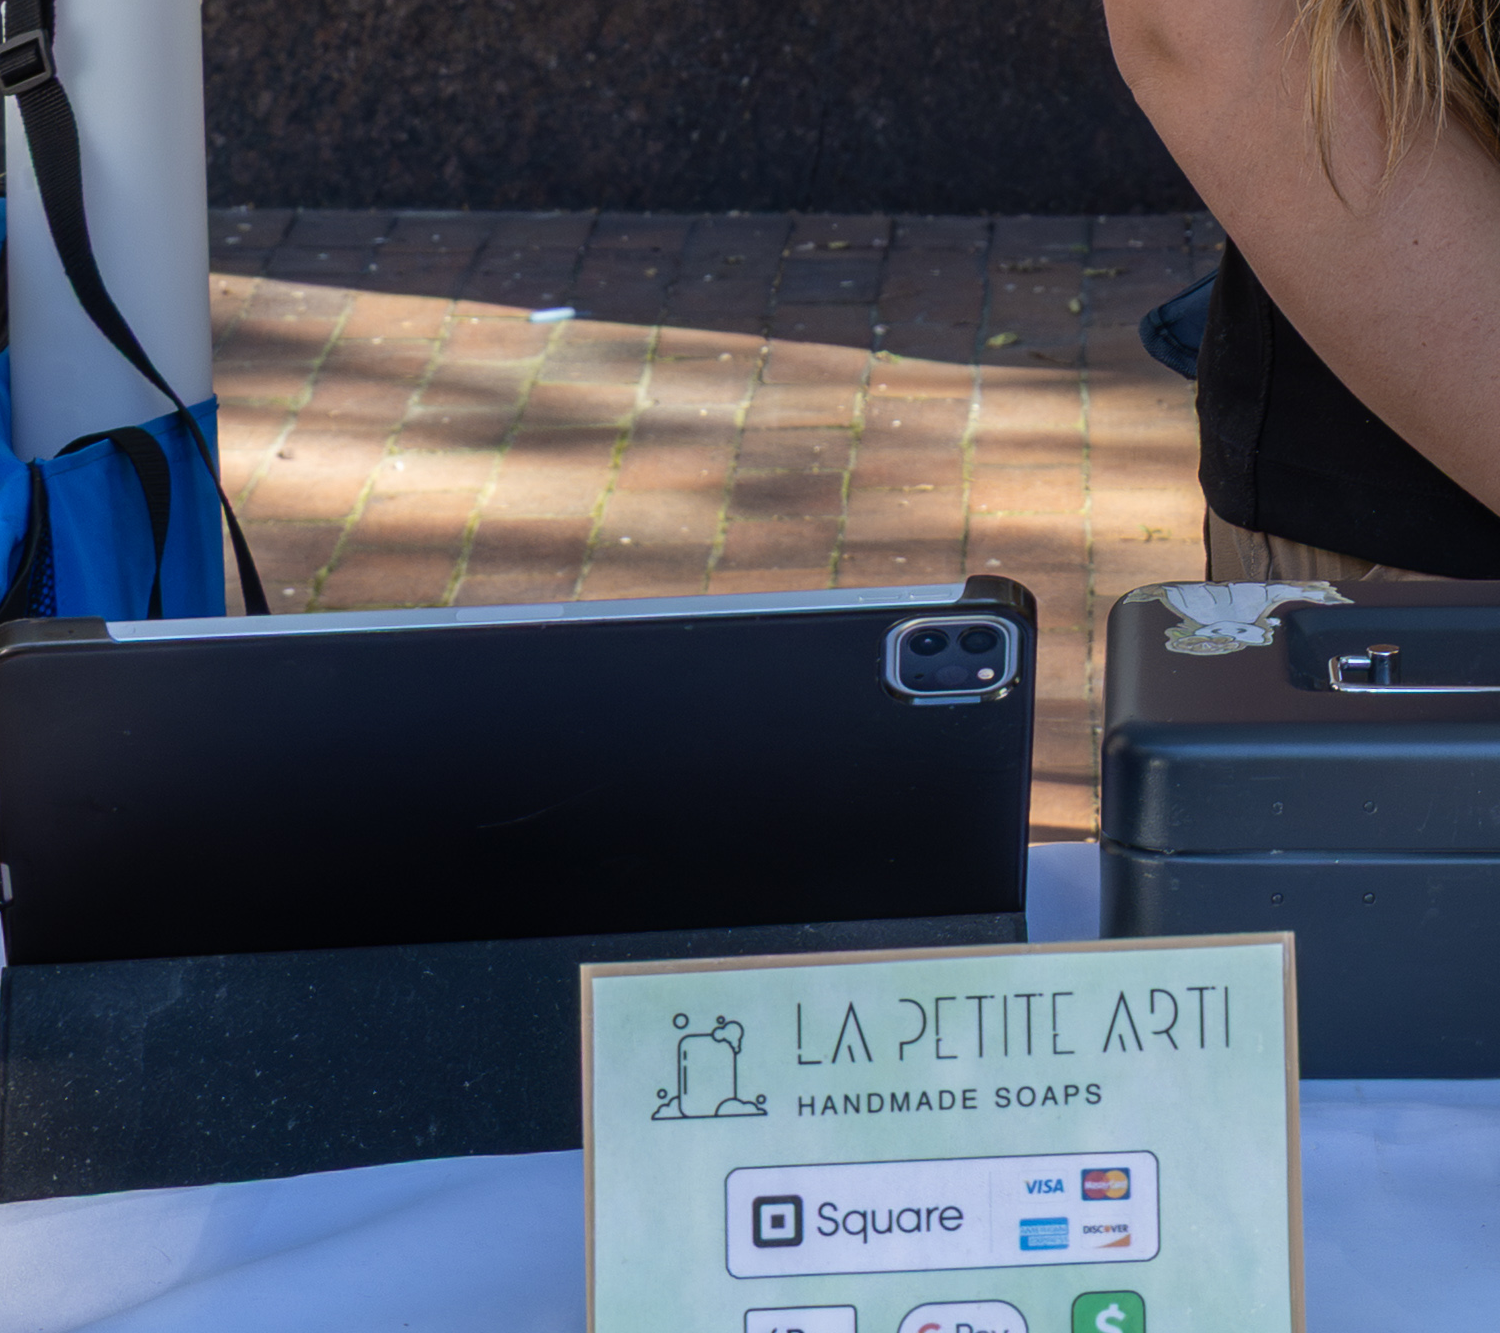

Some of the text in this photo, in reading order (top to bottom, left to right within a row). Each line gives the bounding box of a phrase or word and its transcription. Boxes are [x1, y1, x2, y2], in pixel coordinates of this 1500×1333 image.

[796, 985, 1230, 1066] LA PETITE ARTI
[798, 1083, 1102, 1117] HANDMADE SOAPS
[1025, 1178, 1065, 1195] VISA
[816, 1201, 964, 1245] Square
